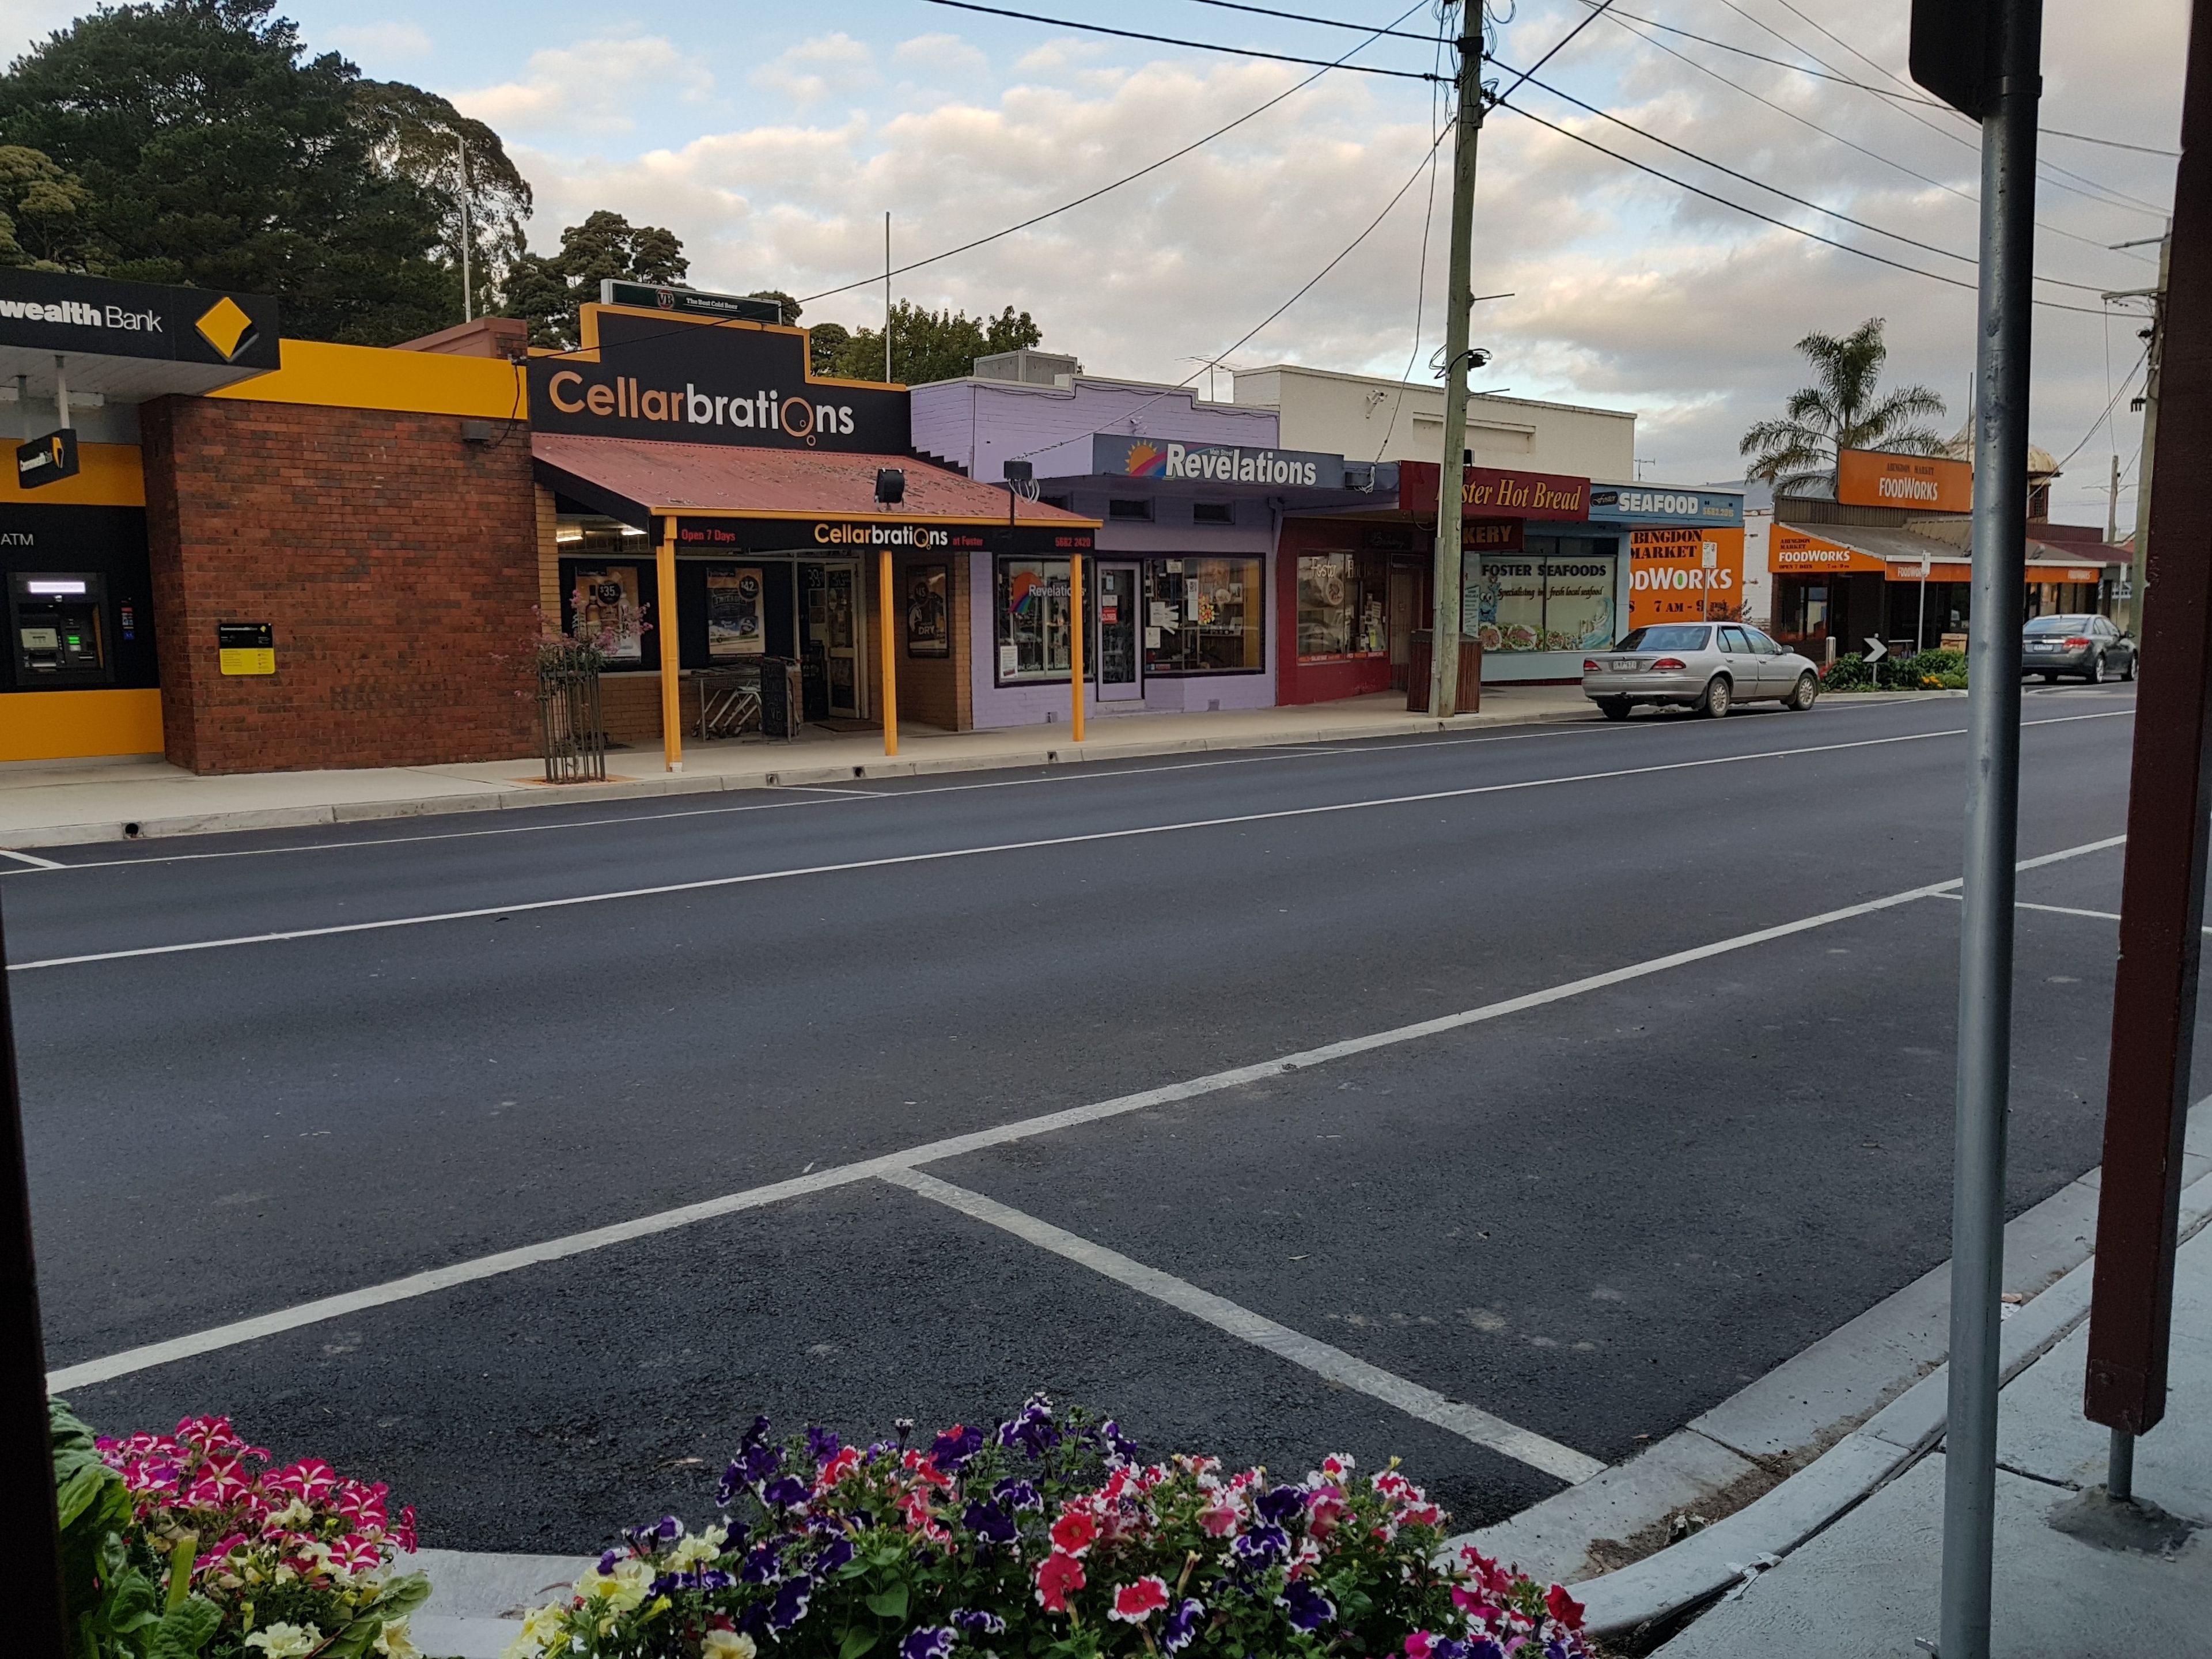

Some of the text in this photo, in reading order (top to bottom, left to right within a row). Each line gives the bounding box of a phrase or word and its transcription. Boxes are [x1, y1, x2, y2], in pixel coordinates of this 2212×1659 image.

[658, 294, 673, 305] VB
[105, 305, 163, 333] Bank
[548, 370, 855, 438] Cellarbrations
[1165, 443, 1317, 486] Revelations
[1887, 463, 1934, 476] ABINGDON MARKET
[1495, 479, 1529, 507] Hot
[1532, 482, 1582, 511] Bread
[1619, 492, 1699, 514] SEAFOOD
[1, 533, 34, 546] ATM
[681, 529, 736, 543] Open 7 Days
[814, 523, 983, 548] Cellarbrations at Foster
[1631, 529, 1703, 544] BINGDON
[1482, 564, 1607, 577] FOSTER SEAFOODS
[600, 585, 615, 597] $35
[741, 581, 755, 592] $42
[1029, 584, 1085, 597] Revelatios
[1497, 586, 1535, 600] Specialising
[1547, 586, 1565, 600] fresh
[1566, 586, 1582, 596] local
[1581, 586, 1604, 600] seafood
[1654, 600, 1662, 612] 7
[1666, 603, 1684, 612] AM
[1696, 599, 1703, 612] 9
[918, 625, 935, 635] DRY
